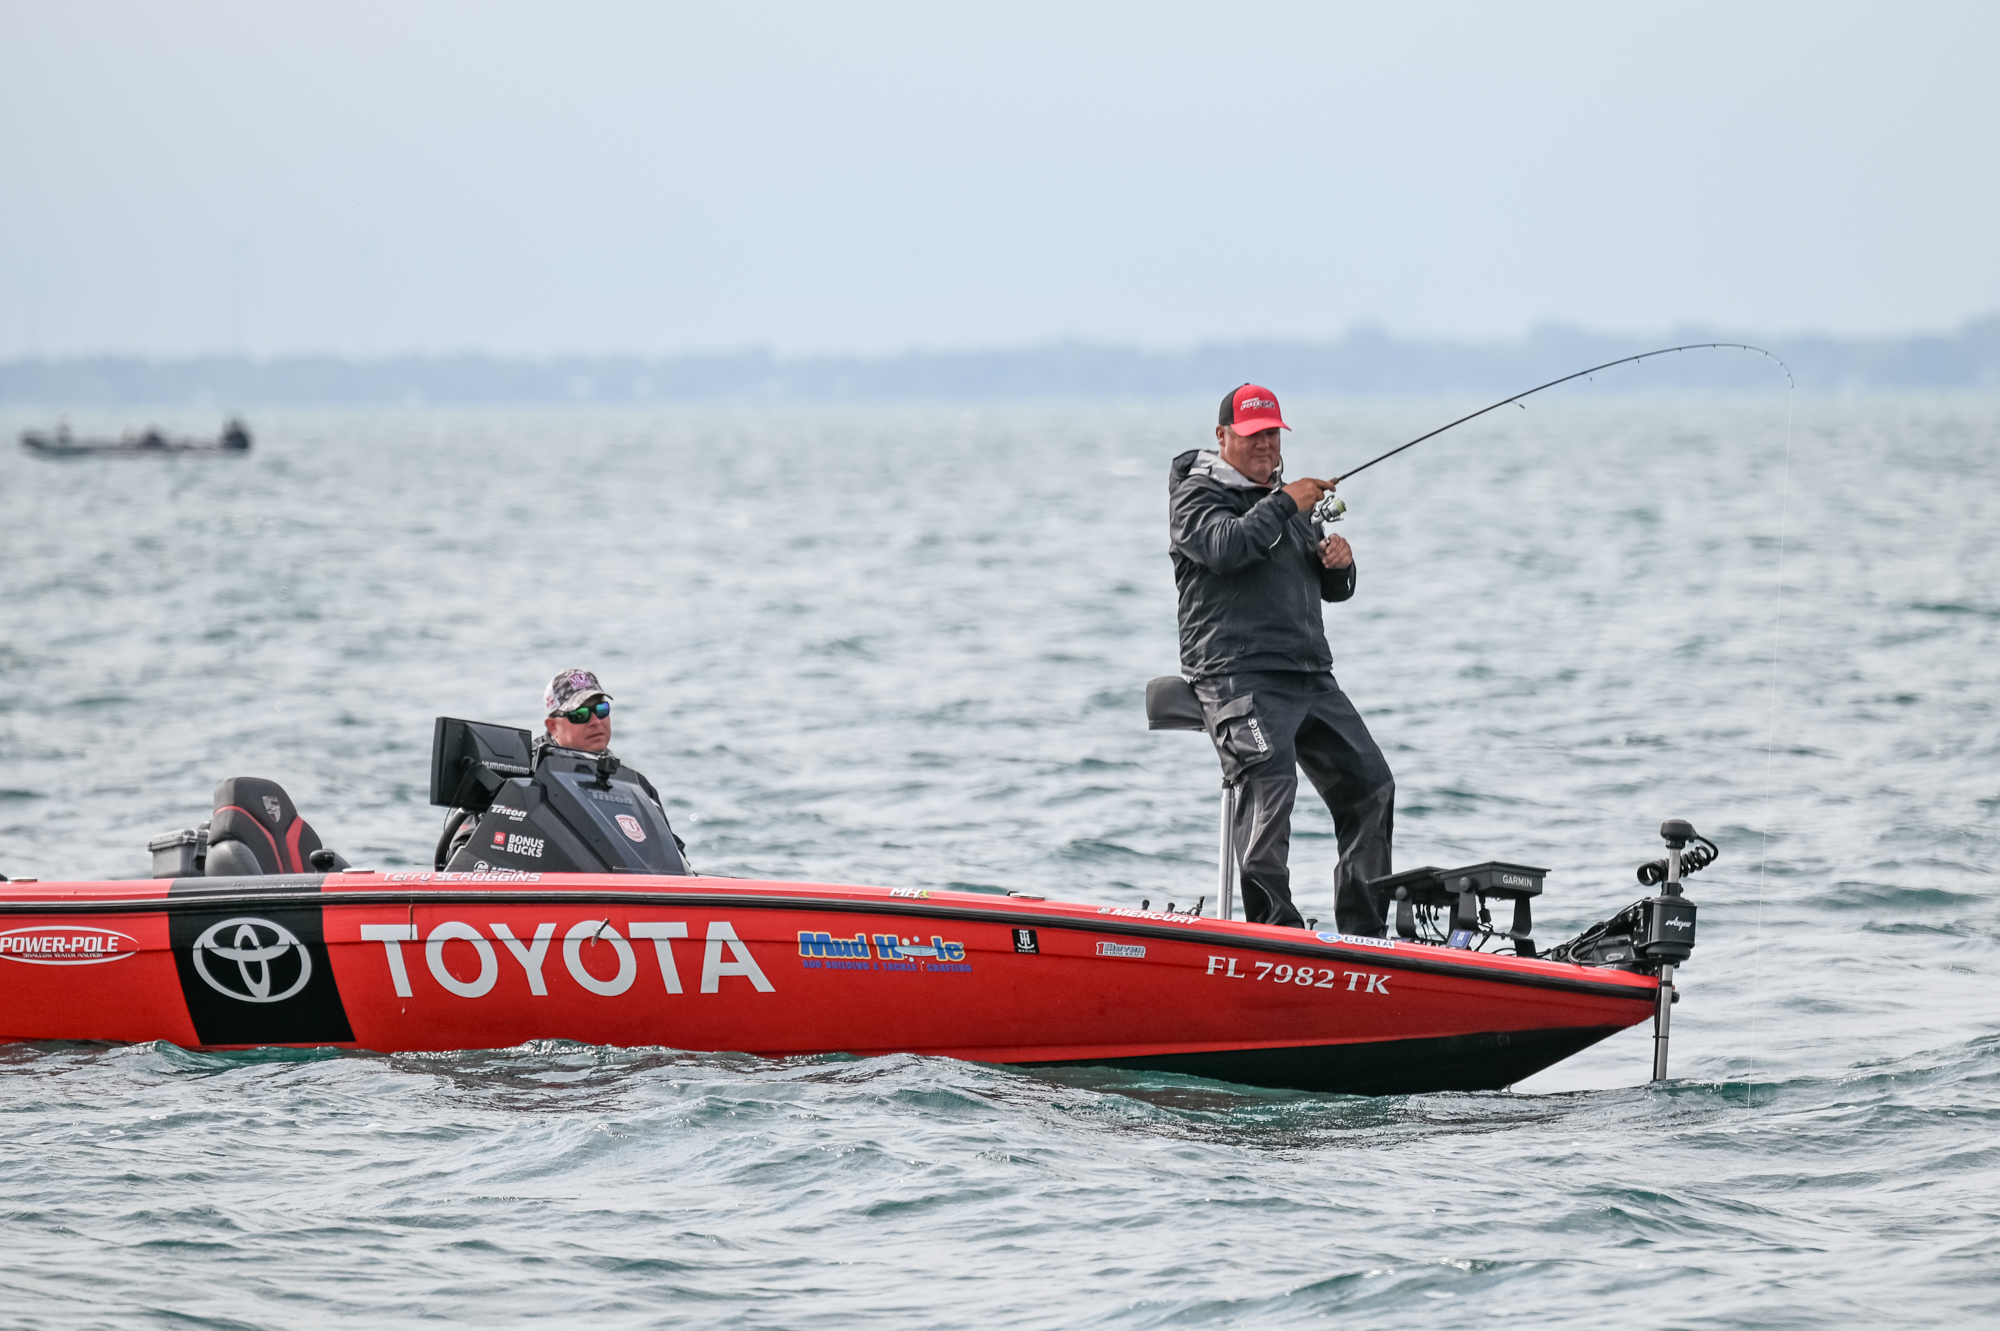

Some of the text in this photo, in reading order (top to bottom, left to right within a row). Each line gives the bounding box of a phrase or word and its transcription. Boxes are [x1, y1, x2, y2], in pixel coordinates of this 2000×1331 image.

[588, 789, 633, 806] Triton
[491, 804, 527, 817] Triton
[508, 833, 545, 850] BONUS
[506, 843, 543, 858] BUCKS
[434, 872, 543, 882] SCROGGINS
[1502, 874, 1533, 887] GARMIN
[1111, 908, 1201, 925] MERCURY
[0, 936, 119, 953] POWER-POLE
[797, 931, 872, 959] Mud
[1343, 935, 1394, 949] COSTA
[360, 920, 776, 998] TOYOTA
[802, 960, 822, 969] ROD
[826, 960, 870, 970] BUILDING
[882, 963, 918, 972] TACKLE
[926, 964, 973, 973] CRAFTING
[1205, 955, 1392, 995] FL 7982 TK
